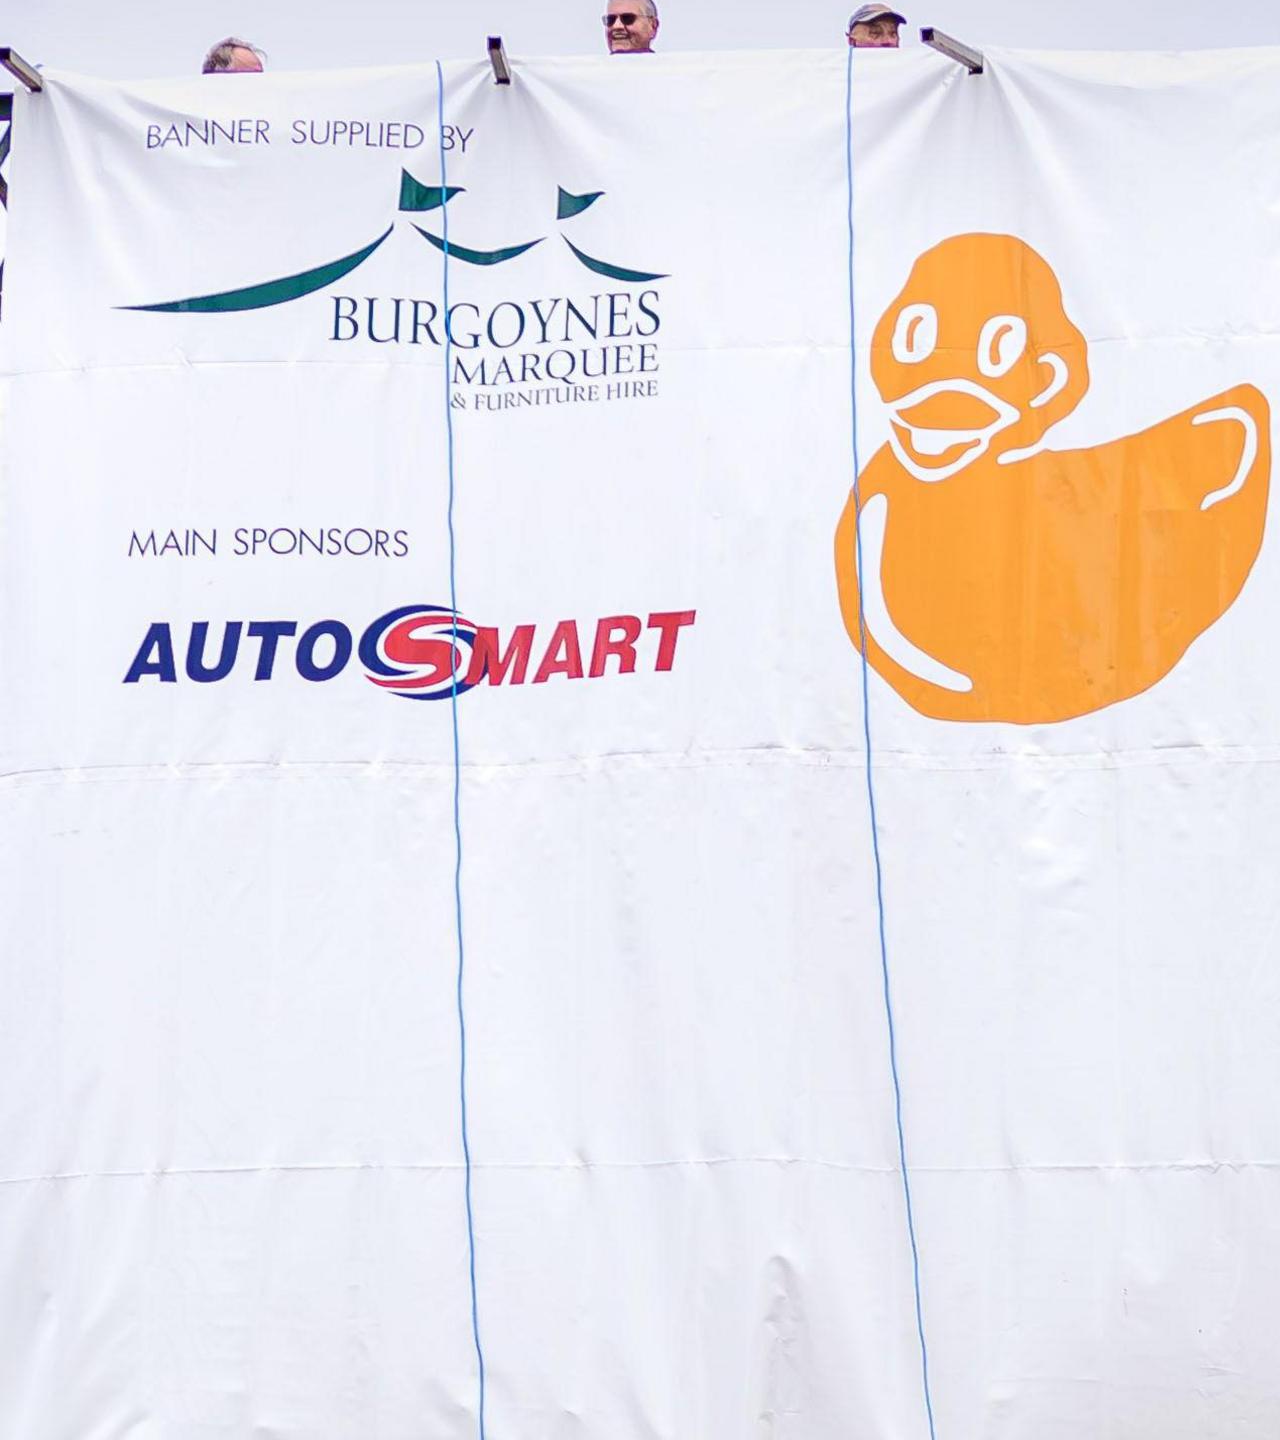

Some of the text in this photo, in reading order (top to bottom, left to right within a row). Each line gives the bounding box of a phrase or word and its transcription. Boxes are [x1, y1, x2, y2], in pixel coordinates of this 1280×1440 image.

[147, 119, 474, 153] BANNER SUPPLIED BY
[328, 290, 661, 349] BURGOYNES
[452, 343, 660, 387] MARQUEE
[450, 379, 659, 411] & FURNITURE HIRE
[128, 527, 410, 558] MAIN SPONSORS
